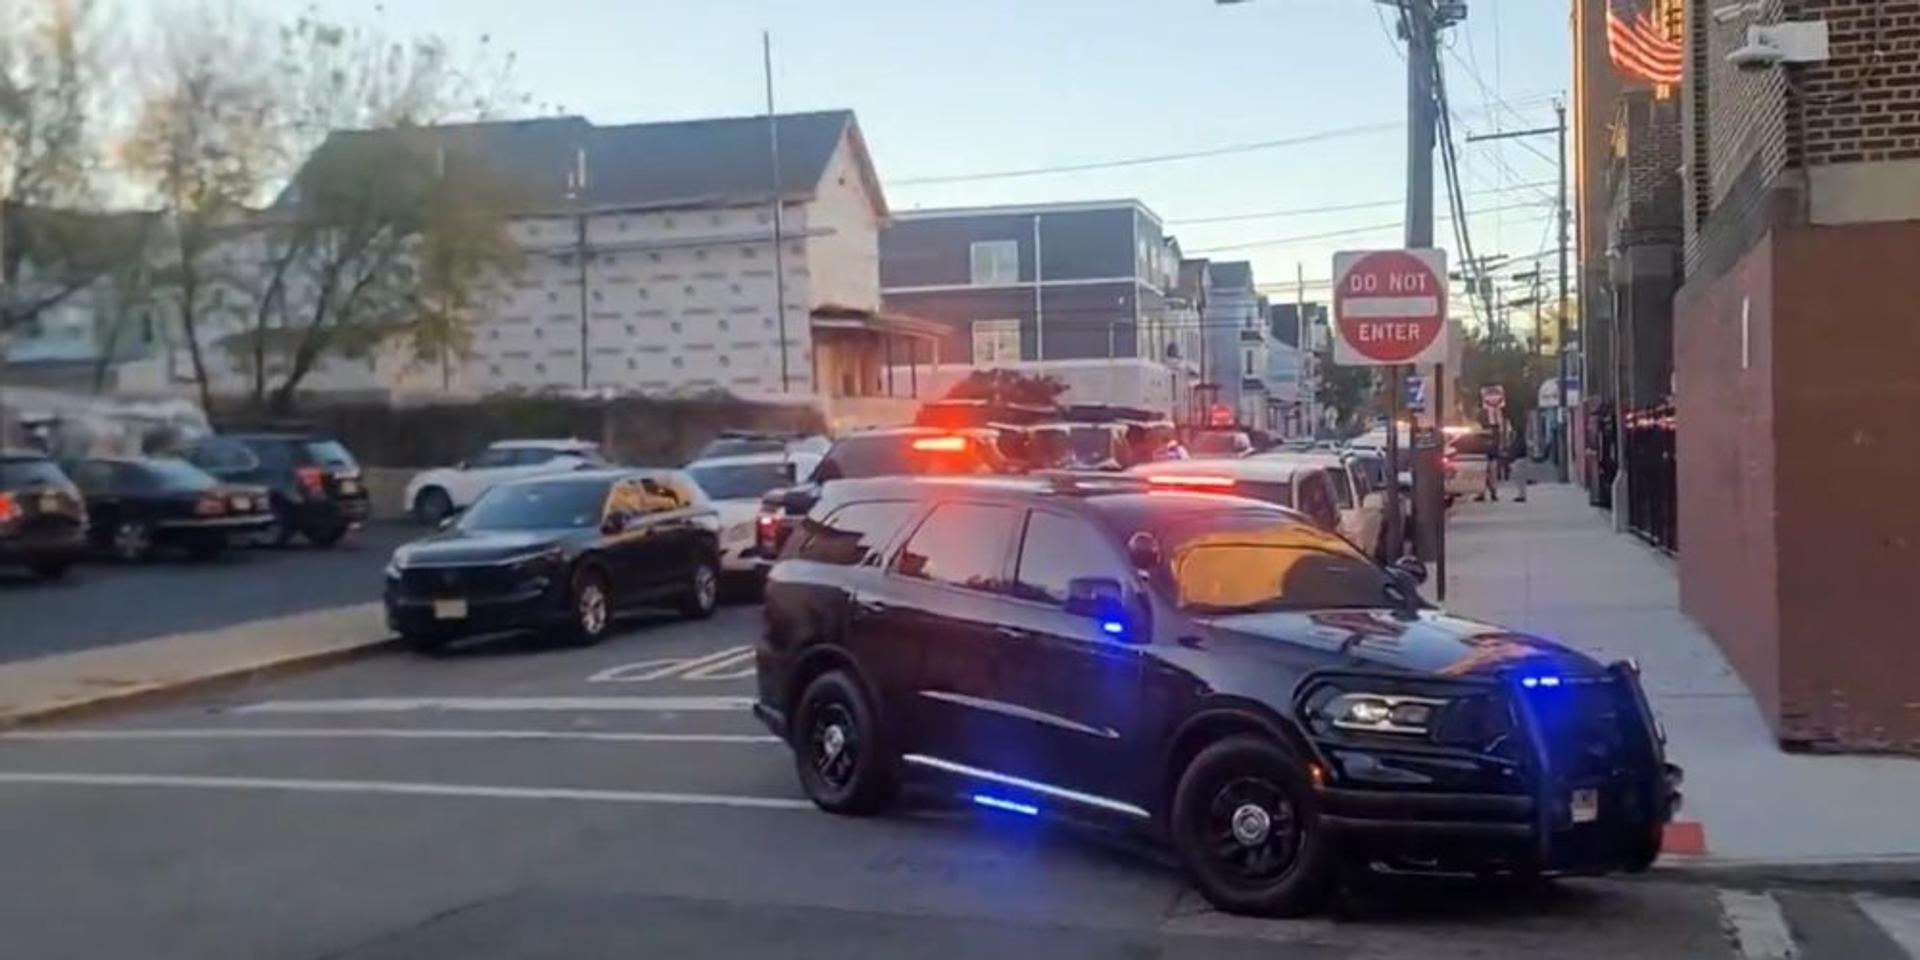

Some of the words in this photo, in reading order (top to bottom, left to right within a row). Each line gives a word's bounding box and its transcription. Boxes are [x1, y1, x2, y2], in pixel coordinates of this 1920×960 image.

[1350, 273, 1378, 292] DO
[1388, 272, 1426, 292] NOT
[1359, 323, 1420, 341] ENTER
